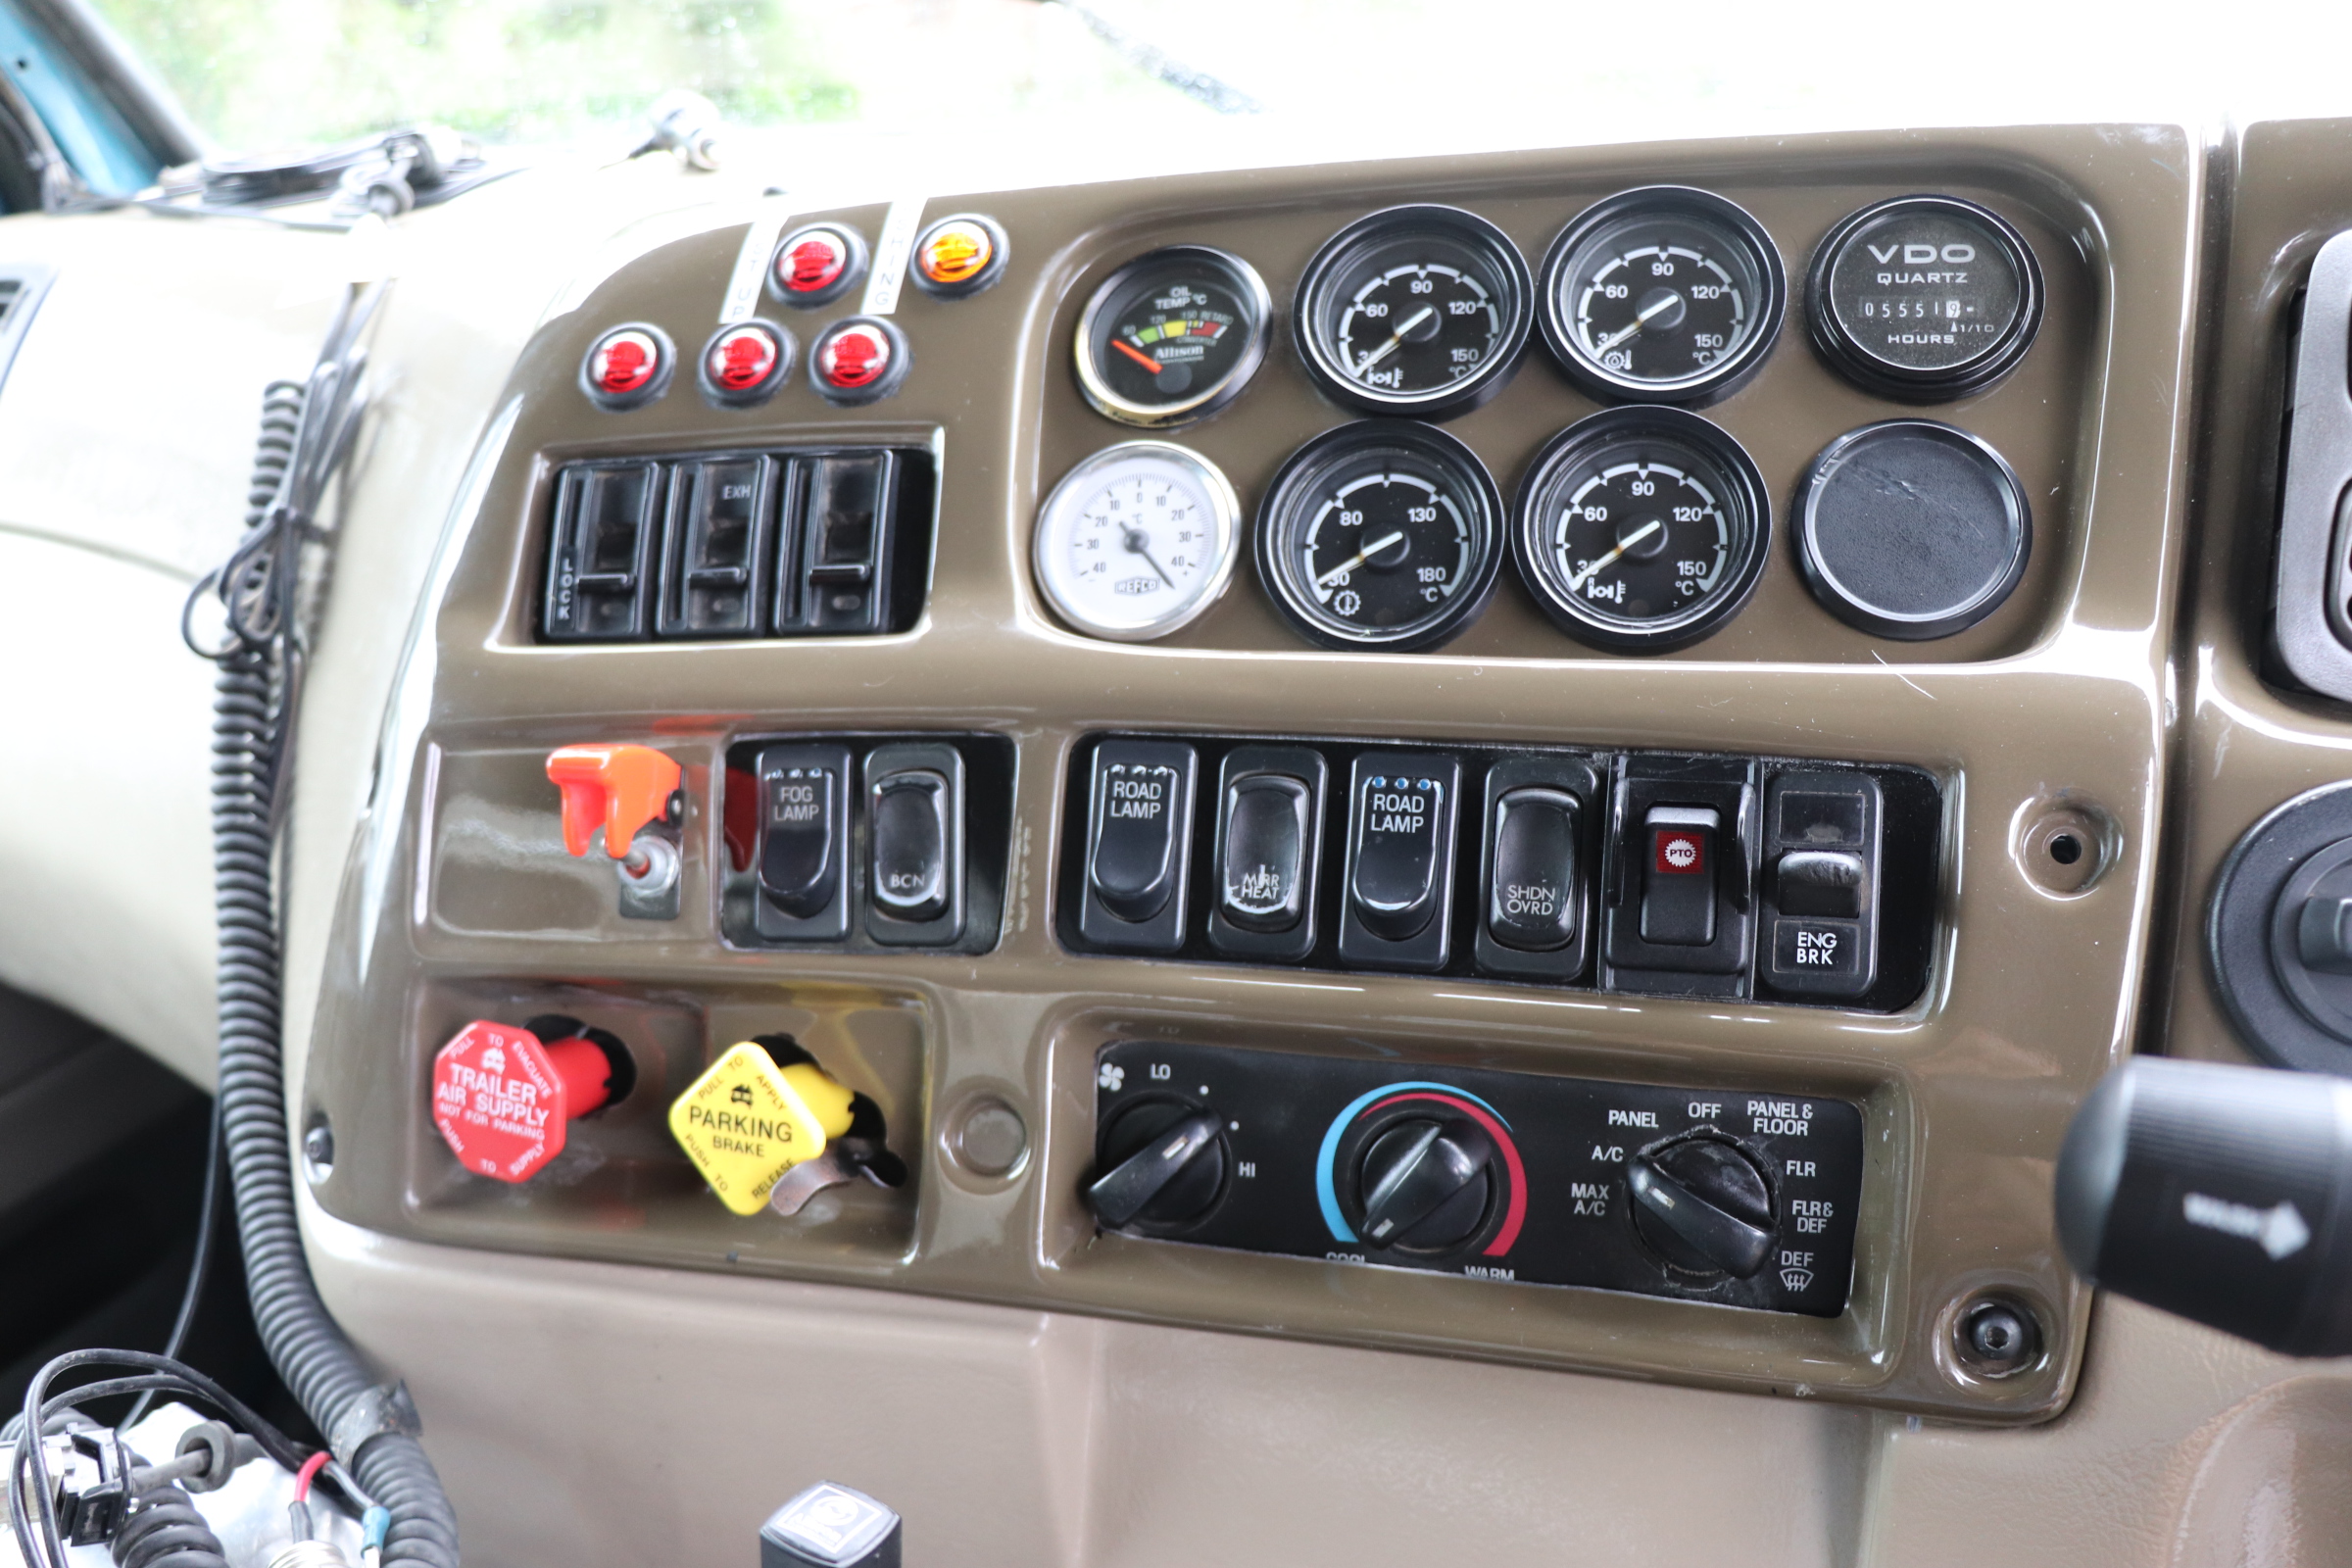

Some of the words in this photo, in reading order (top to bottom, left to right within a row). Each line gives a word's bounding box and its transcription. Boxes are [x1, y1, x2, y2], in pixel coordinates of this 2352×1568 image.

[1867, 244, 1976, 264] VDO
[1651, 262, 1674, 276] 90
[1877, 272, 1968, 285] QUARTZ
[1170, 286, 1192, 297] OIL
[1410, 280, 1433, 294] 90
[1605, 284, 1628, 298] 60
[1691, 286, 1720, 299] 120
[1154, 296, 1191, 311] TEMP
[1365, 304, 1389, 318] 60
[1448, 301, 1476, 315] 120
[1151, 315, 1166, 324] 120
[1180, 310, 1198, 320] 150
[1960, 324, 1994, 333] 1/10
[1694, 334, 1723, 348] 150
[1887, 334, 1955, 344] HOURS
[1154, 345, 1204, 360] Allison
[1450, 349, 1479, 363] 150
[723, 485, 752, 500] EXH
[1632, 481, 1655, 497] 90
[1110, 499, 1120, 511] 10
[1137, 492, 1143, 504] 0
[1156, 495, 1166, 507] 10
[1096, 515, 1108, 527] 20
[1172, 509, 1185, 520] 20
[1340, 511, 1363, 525] 80
[1407, 508, 1437, 522] 130
[1584, 507, 1607, 521] 60
[1673, 508, 1702, 521] 120
[1087, 539, 1100, 550] 30
[1179, 531, 1192, 543] 30
[1093, 562, 1106, 572] 40
[1171, 556, 1185, 566] 40
[1417, 567, 1446, 582] 180
[1677, 562, 1706, 576] 150
[1118, 578, 1157, 594] REFCO
[1328, 572, 1350, 587] 30
[559, 558, 573, 620] LOCK
[781, 786, 813, 803] FOG
[1113, 781, 1162, 800] ROAD
[1110, 801, 1161, 818] LAMP
[1373, 794, 1424, 813] ROAD
[774, 805, 819, 821] LAMP
[1370, 813, 1424, 833] LAMP
[1669, 849, 1692, 858] PTO
[891, 874, 925, 889] BCN
[1242, 885, 1280, 899] HEAT
[1507, 885, 1555, 901] SHDN
[1507, 901, 1553, 915] OVRD
[1797, 931, 1838, 949] ENG
[1796, 949, 1833, 965] BRK
[450, 1037, 475, 1059] PULL
[488, 1033, 504, 1048] TO
[512, 1041, 553, 1100] EVACUATE
[1150, 1063, 1171, 1080] LO
[450, 1062, 537, 1105] TRAILER
[698, 1077, 724, 1100] PULL
[728, 1056, 744, 1071] TO
[756, 1075, 787, 1111] APPLY
[438, 1082, 467, 1105] AIR
[475, 1094, 550, 1128] SUPPLY
[1688, 1102, 1722, 1119] OFF
[1747, 1101, 1798, 1119] PANEL
[1802, 1104, 1813, 1119] &
[440, 1102, 461, 1117] NOT
[465, 1111, 488, 1126] FOR
[493, 1117, 545, 1141] PARKING
[689, 1105, 793, 1143] PARKING
[1608, 1109, 1659, 1128] PANEL
[1753, 1117, 1808, 1136] FLOOR
[440, 1118, 465, 1153] PUSH
[480, 1158, 497, 1173] TO
[509, 1142, 545, 1175] SUPPLY
[712, 1136, 764, 1157] BRAKE
[1592, 1146, 1624, 1162] A/C
[685, 1134, 710, 1168] PUSH
[714, 1174, 728, 1193] TO
[752, 1158, 795, 1200] RELEASE
[1238, 1161, 1256, 1178] HI
[1786, 1160, 1816, 1177] FLR
[1571, 1183, 1609, 1200] MAX
[1574, 1200, 1606, 1215] A/C
[1796, 1216, 1828, 1233] DEF
[1781, 1250, 1814, 1266] DEF
[1464, 1265, 1515, 1281] WARM
